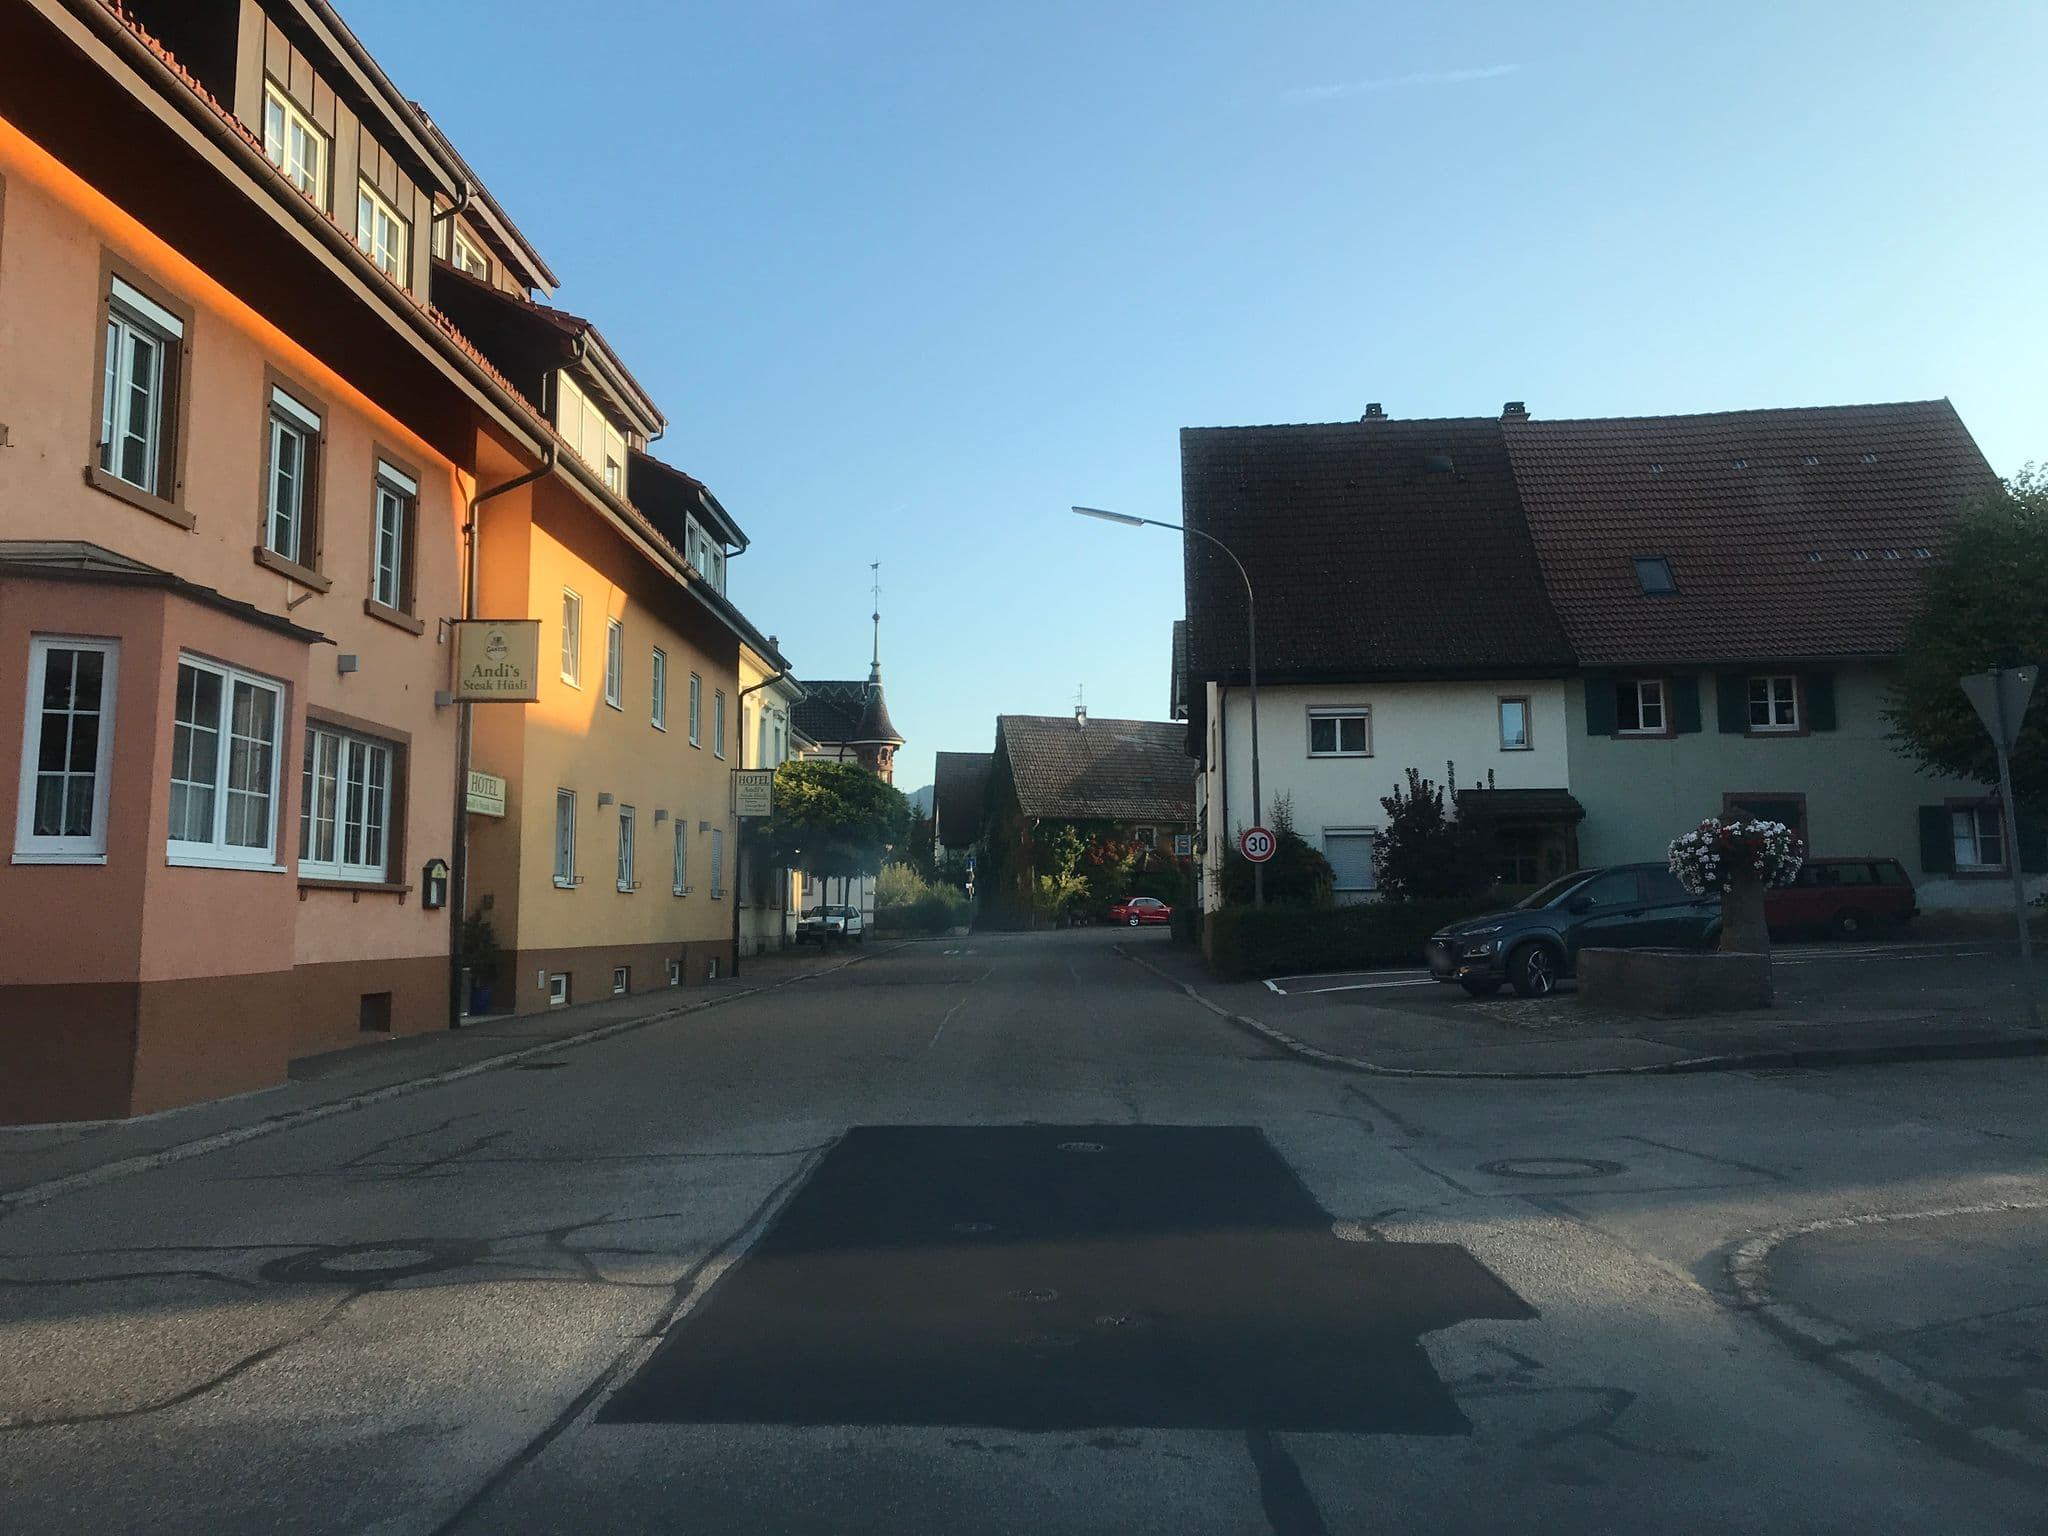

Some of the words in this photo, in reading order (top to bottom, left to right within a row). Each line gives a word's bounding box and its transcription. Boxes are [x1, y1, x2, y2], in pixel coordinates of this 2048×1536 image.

[463, 680, 493, 690] Steak
[497, 680, 528, 690] Hüsli
[471, 774, 498, 796] HOTEL
[738, 775, 769, 785] HOTEL
[1248, 836, 1268, 852] 30
